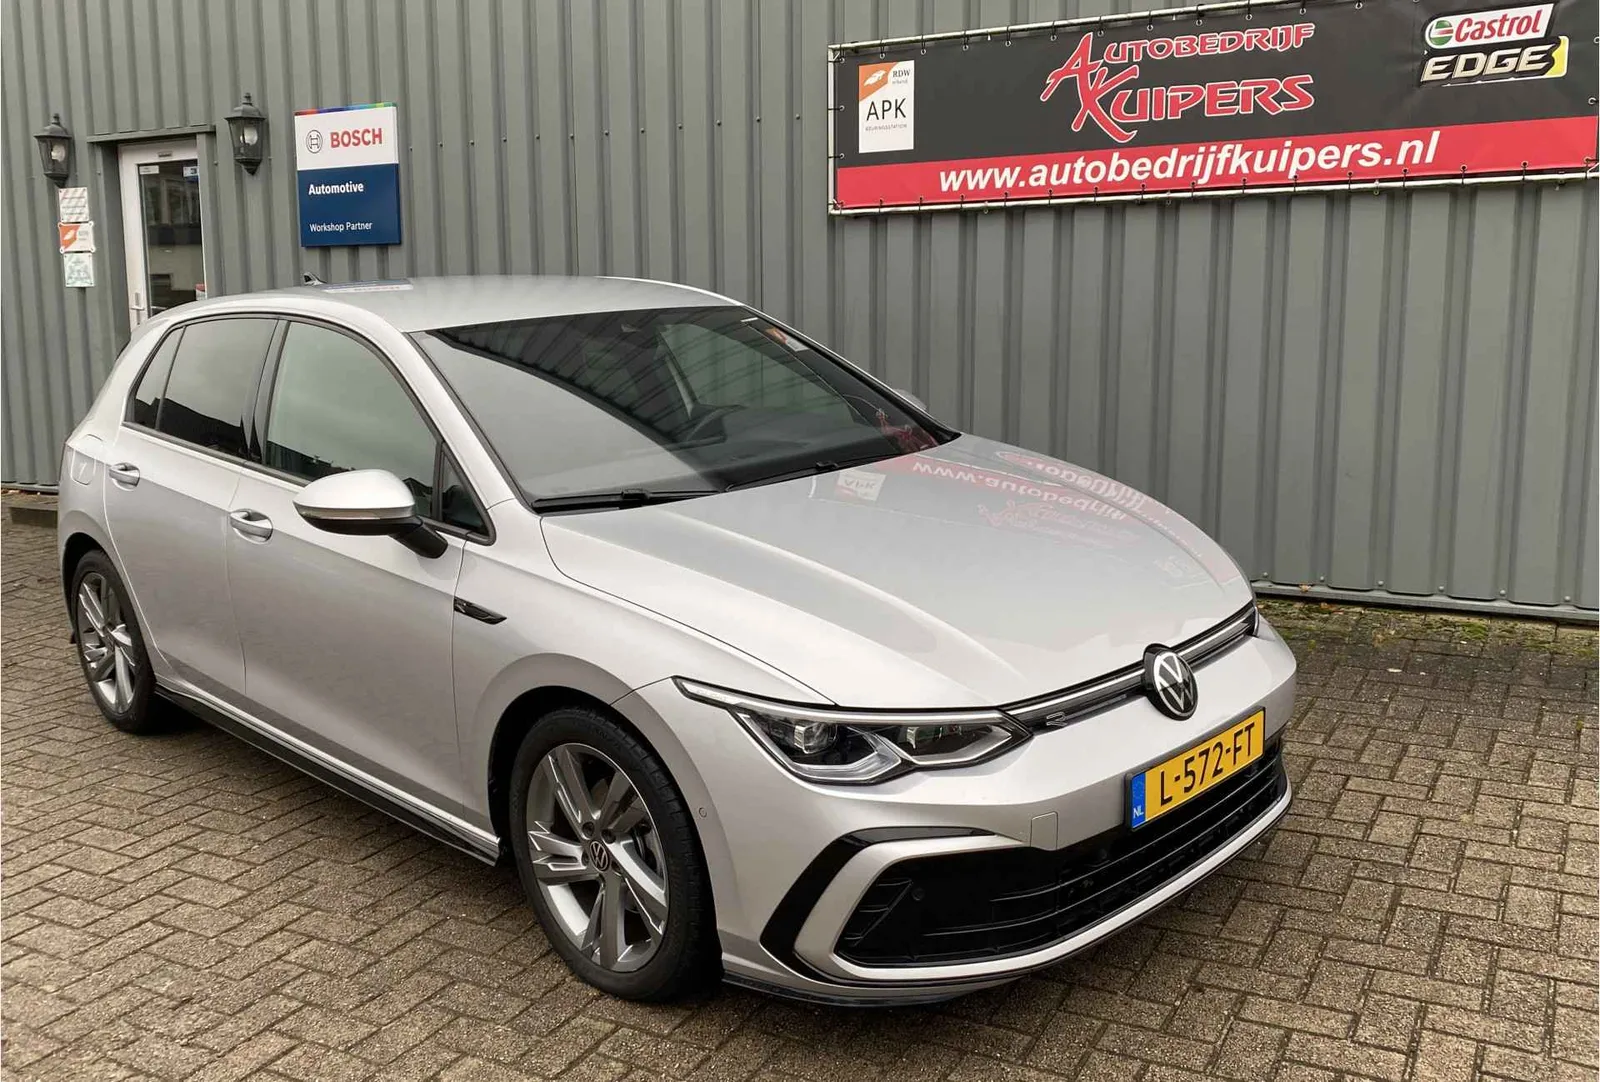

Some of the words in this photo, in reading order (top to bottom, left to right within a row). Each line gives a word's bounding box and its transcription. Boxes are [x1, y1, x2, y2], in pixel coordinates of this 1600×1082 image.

[1455, 9, 1543, 43] Castrol
[892, 69, 911, 78] RDW
[1040, 23, 1315, 102] AUTOBEDRIJF
[1420, 44, 1555, 82] EDGE
[866, 98, 906, 121] APK
[1071, 65, 1315, 143] KUIPERS
[330, 128, 383, 149] BOSCH
[940, 130, 1441, 192] www.autobedrijfkuipers.nl
[308, 181, 364, 195] Automotive
[310, 222, 345, 233] Workshop
[346, 221, 373, 231] Partner
[1160, 722, 1255, 807] L-572-FT
[1132, 805, 1144, 819] NL
